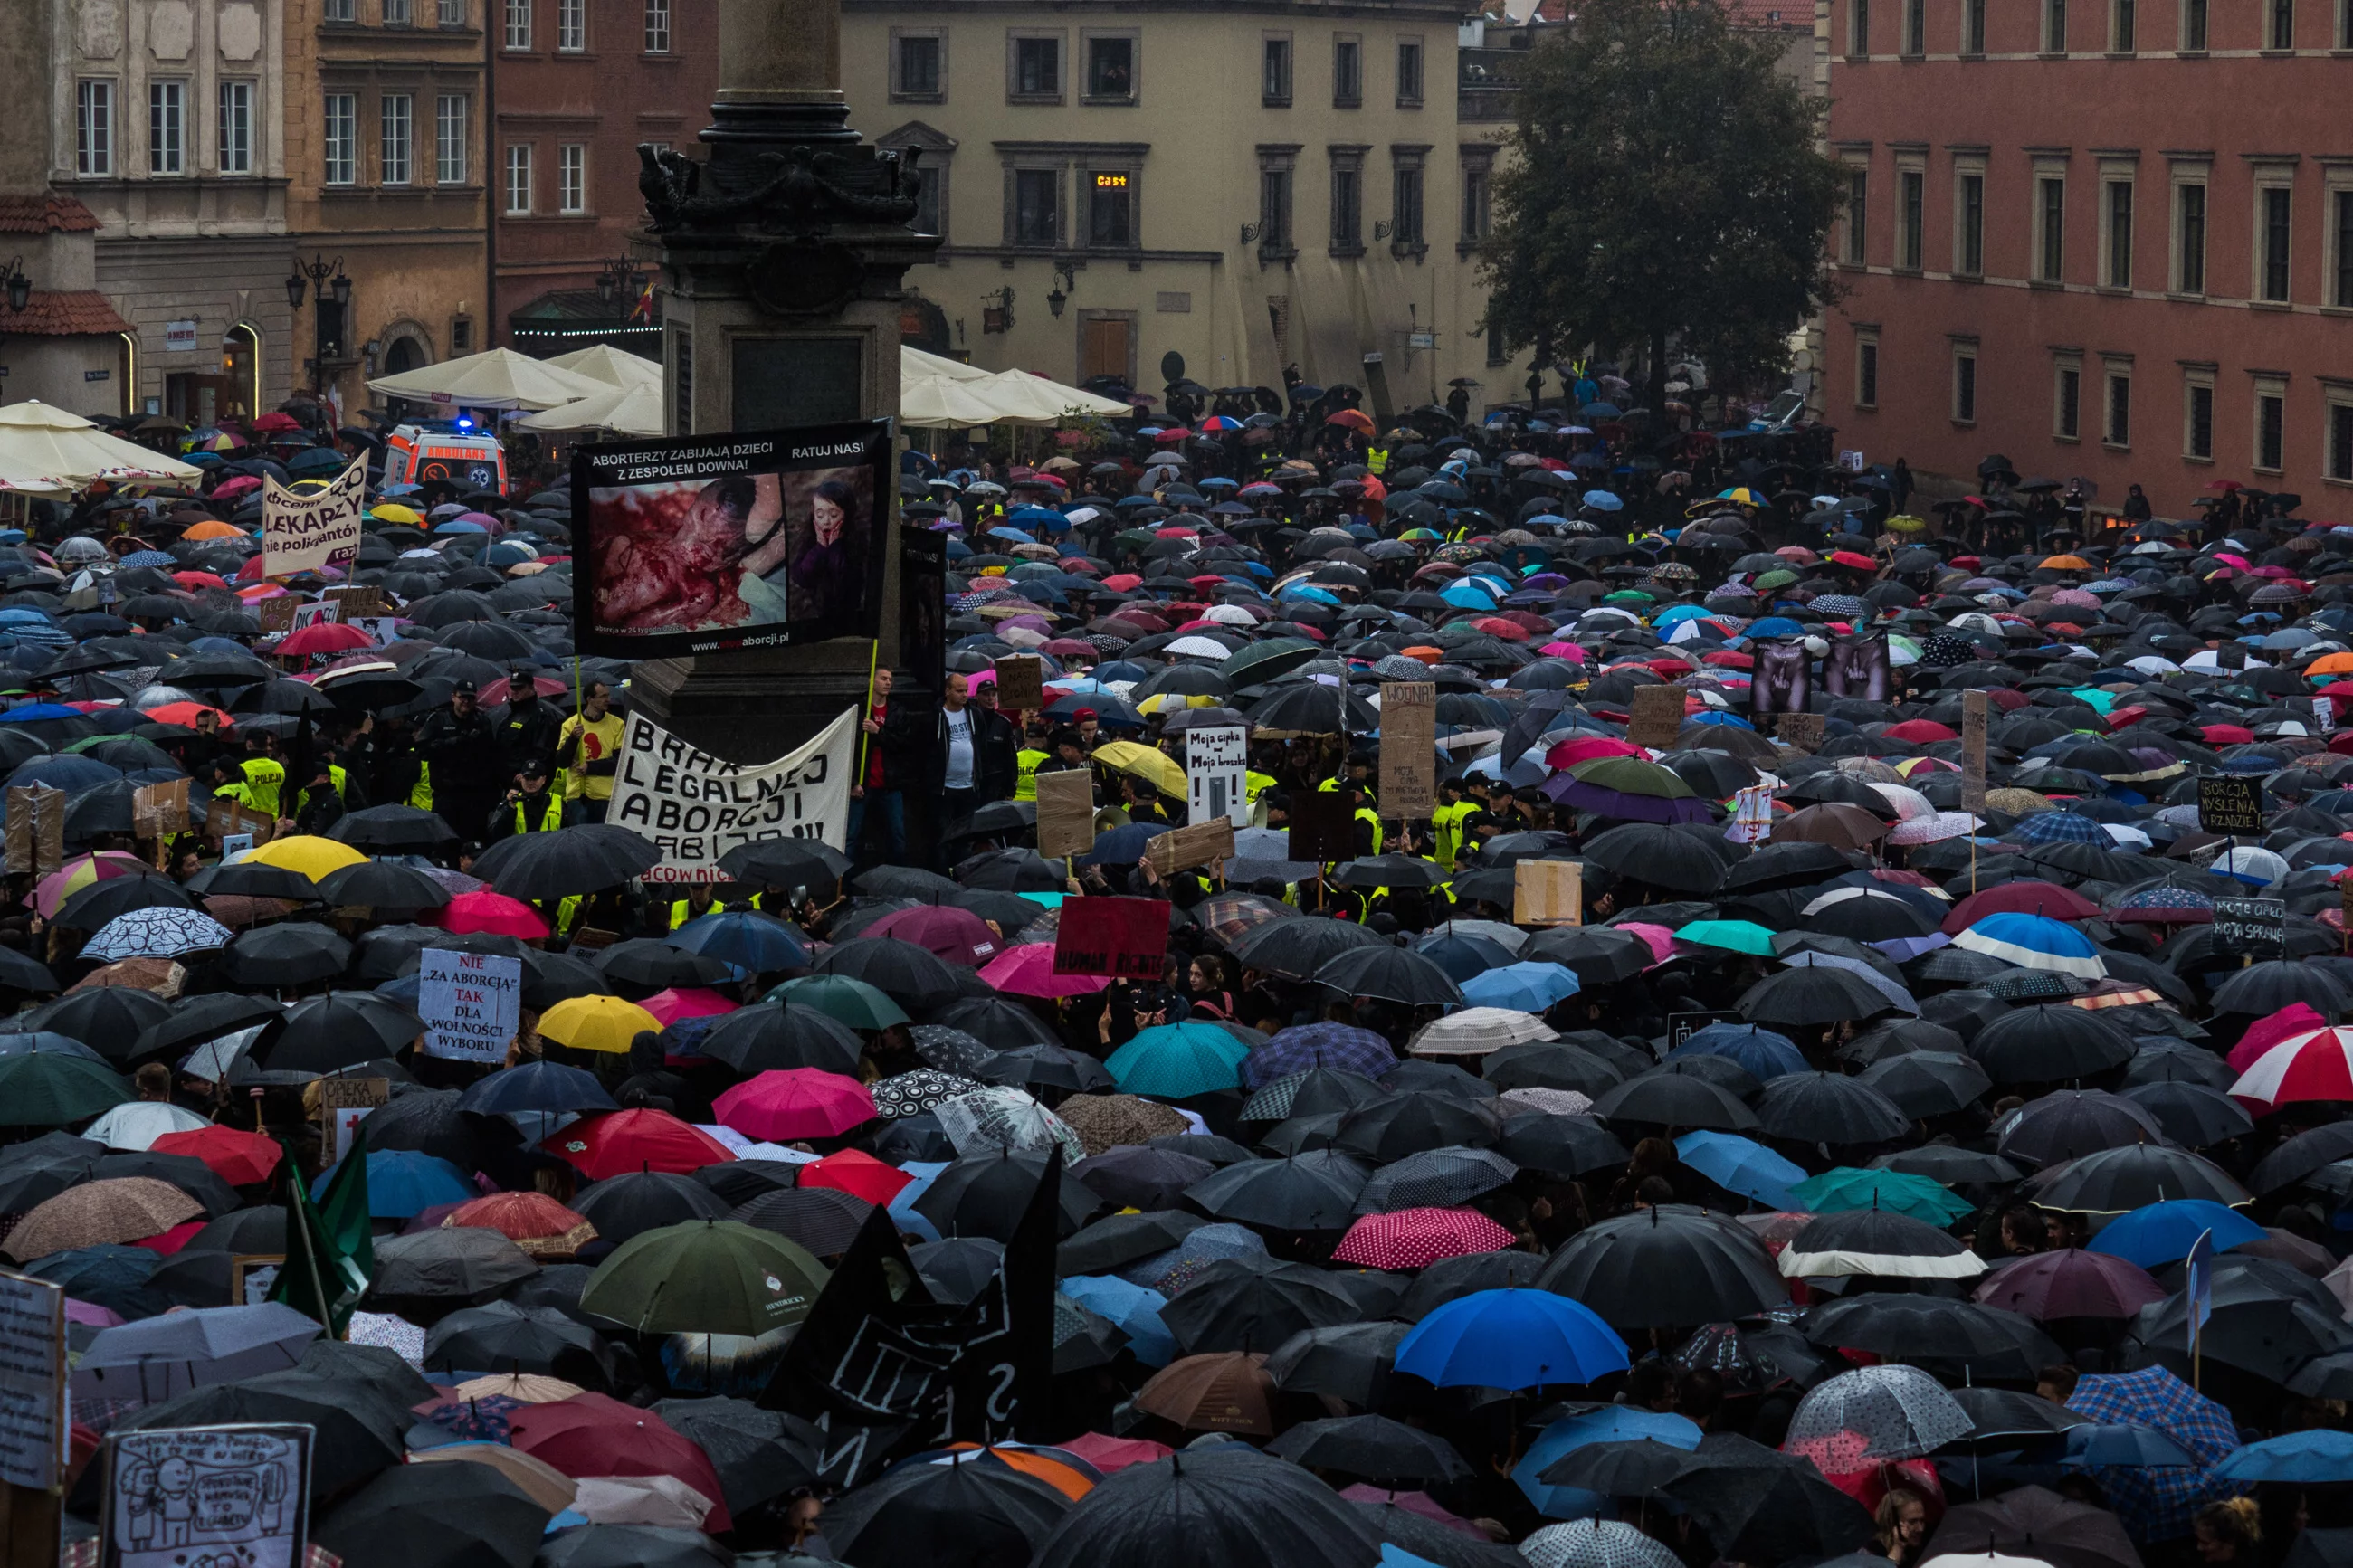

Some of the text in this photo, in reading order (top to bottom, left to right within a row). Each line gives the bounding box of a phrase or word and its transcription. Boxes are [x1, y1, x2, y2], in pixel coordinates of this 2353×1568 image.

[1097, 176, 1127, 186] Cast
[427, 446, 487, 461] AMBULANS
[592, 442, 774, 467] ABORTERZY ZABIJAJĄ DZIECI
[791, 442, 866, 459] RATUJ NAS!
[617, 459, 749, 480] Z ZESPOŁEM DOWNA!
[266, 495, 362, 536] LEKARZY
[334, 546, 357, 560] raz
[691, 632, 789, 651] www.stopaborcji.pl
[1190, 731, 1240, 748] Moja cipka
[1018, 766, 1034, 775] OLIC
[1191, 754, 1246, 773] Moja broszka
[624, 754, 828, 803] LEGALNEJ
[621, 793, 802, 833] ABORCJI
[2202, 797, 2258, 813] MYŚLENIA
[2216, 902, 2251, 917] MOJE
[2244, 924, 2285, 944] SPRAWA
[459, 956, 484, 969] NIE
[1057, 951, 1164, 974] HUMAN RIGHTS
[455, 988, 485, 1003] TAK
[455, 1006, 481, 1019] DLA
[432, 1019, 504, 1038] WOLNOŚCI
[438, 1034, 496, 1052] WYBORU
[326, 1081, 370, 1098] OPIEKA
[327, 1094, 389, 1108] LEKARSKA
